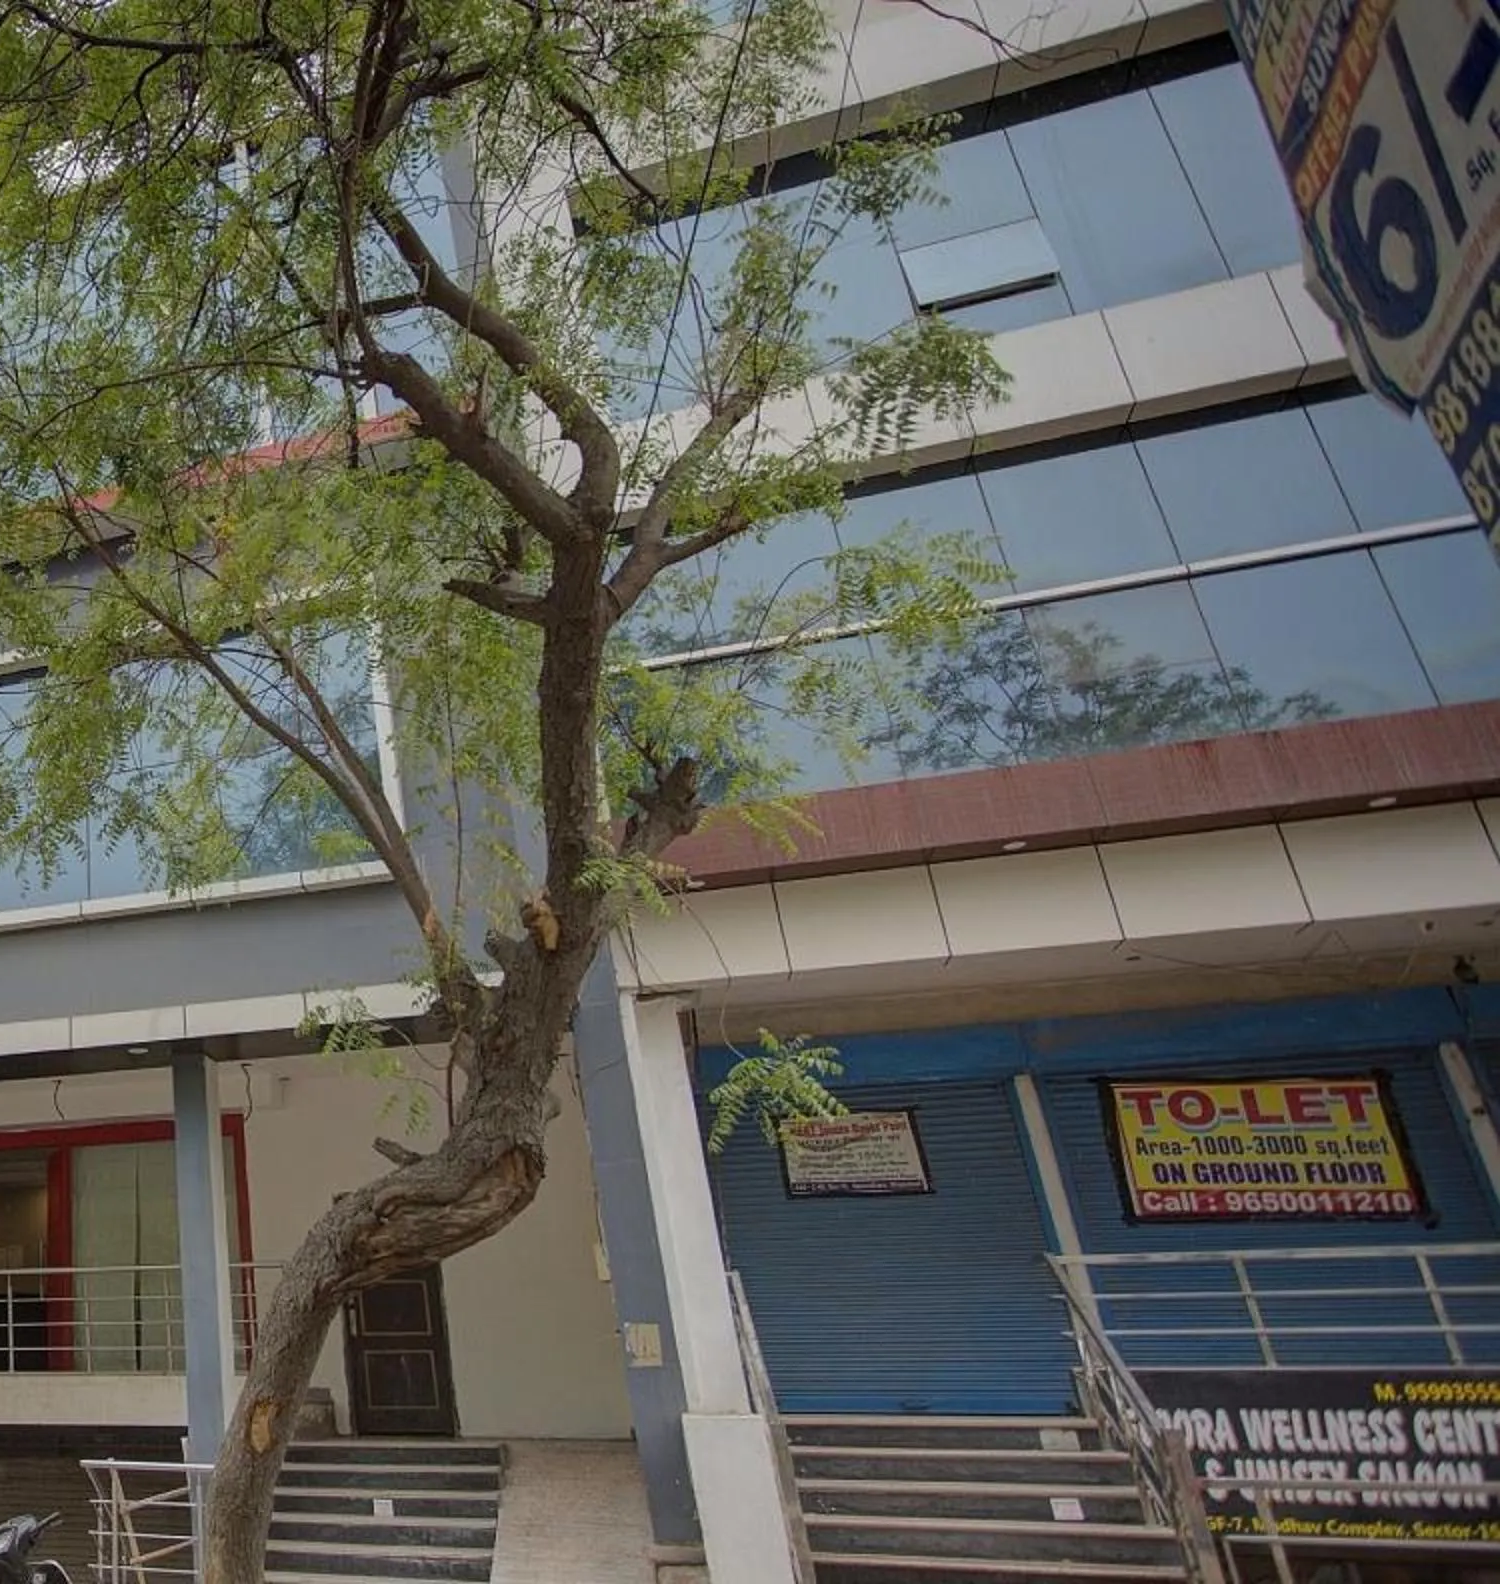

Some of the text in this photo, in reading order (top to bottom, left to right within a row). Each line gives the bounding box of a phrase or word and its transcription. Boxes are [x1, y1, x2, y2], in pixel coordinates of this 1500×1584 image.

[1429, 282, 1500, 453] 98188
[1120, 1086, 1376, 1132] TO-LET
[1135, 1134, 1390, 1159] Area-1000-3000 sq.feet
[1153, 1162, 1387, 1185] ON GROUND FLOOR
[1142, 1191, 1199, 1212] Call
[1227, 1191, 1412, 1212] 9650011210
[1239, 1408, 1409, 1454] WELLNESS
[1413, 1408, 1500, 1455] CENT
[1234, 1458, 1357, 1504] UNISEX
[1358, 1460, 1489, 1509] SALOON
